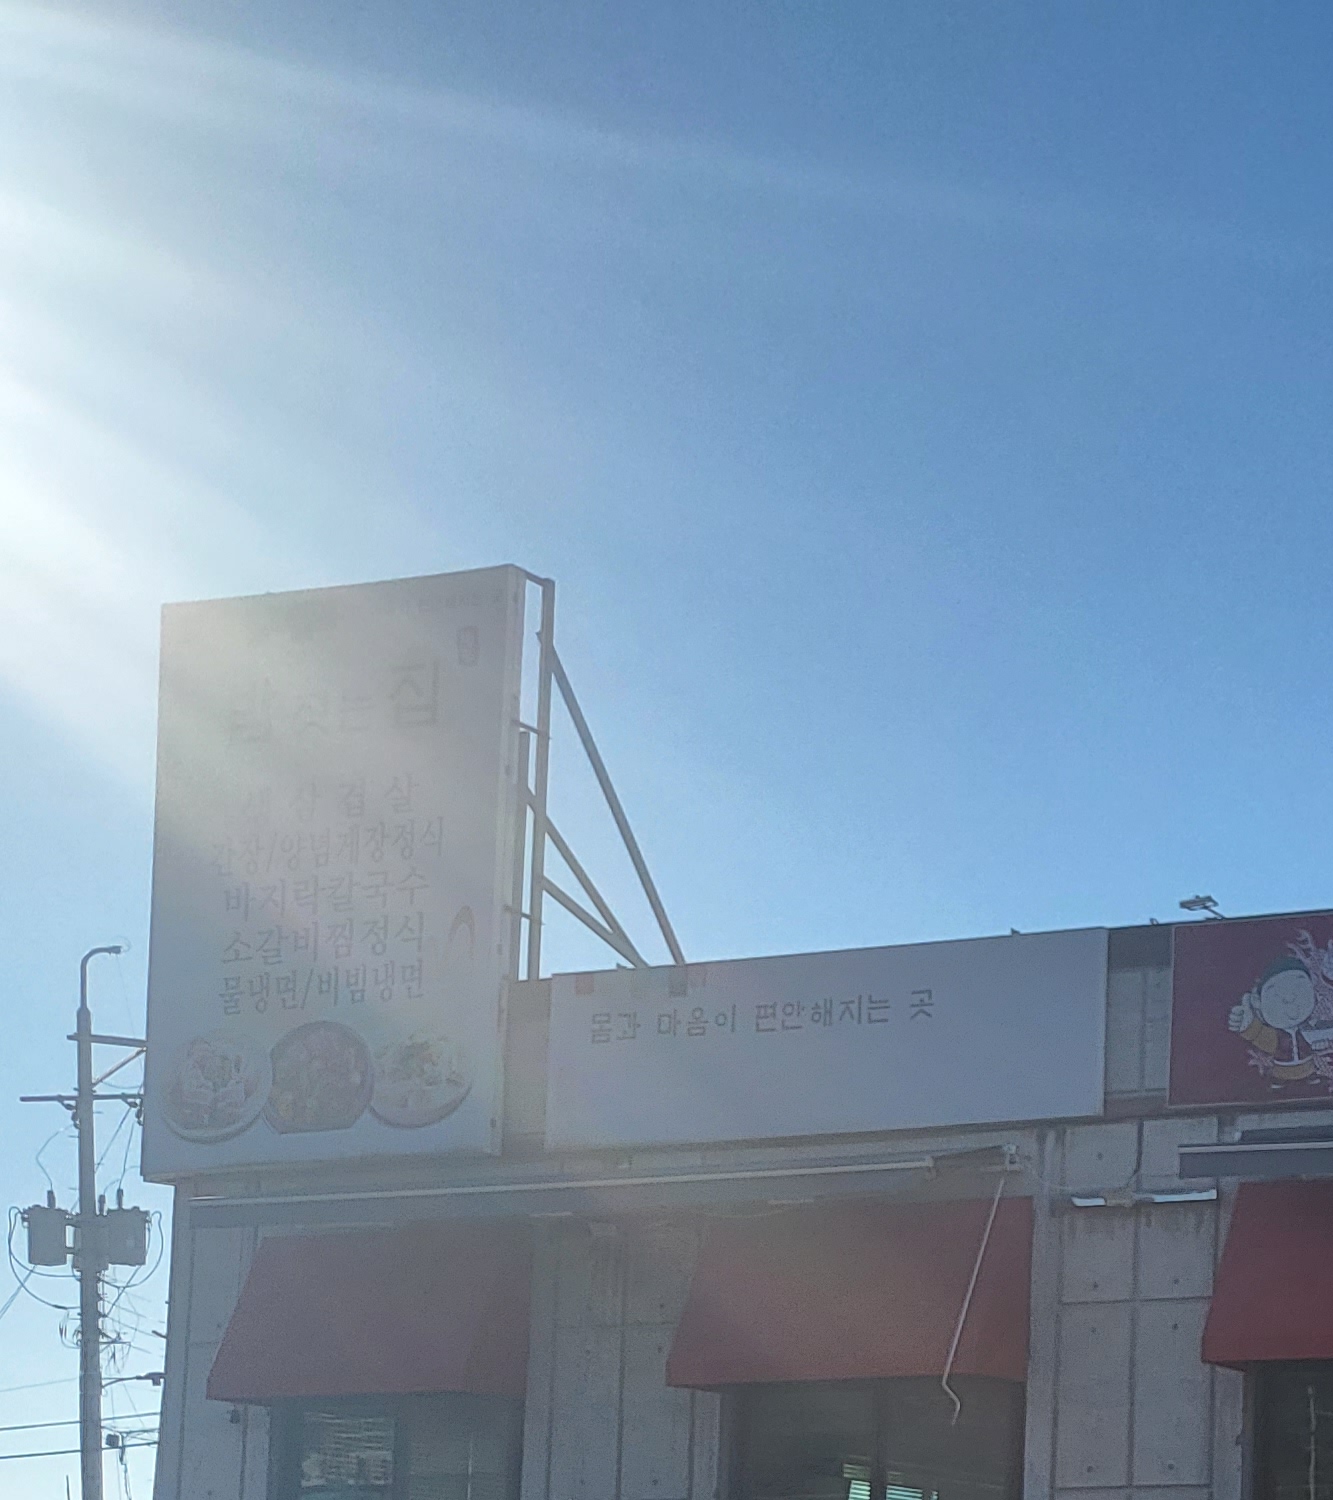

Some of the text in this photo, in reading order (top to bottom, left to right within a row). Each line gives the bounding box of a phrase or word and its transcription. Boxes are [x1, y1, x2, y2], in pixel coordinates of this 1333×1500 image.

[223, 867, 431, 922] 바지락칼국수
[218, 958, 424, 1016] 물냉면/비빔냉면
[590, 988, 935, 1044] 몸과 마음이 편안해지는 곳
